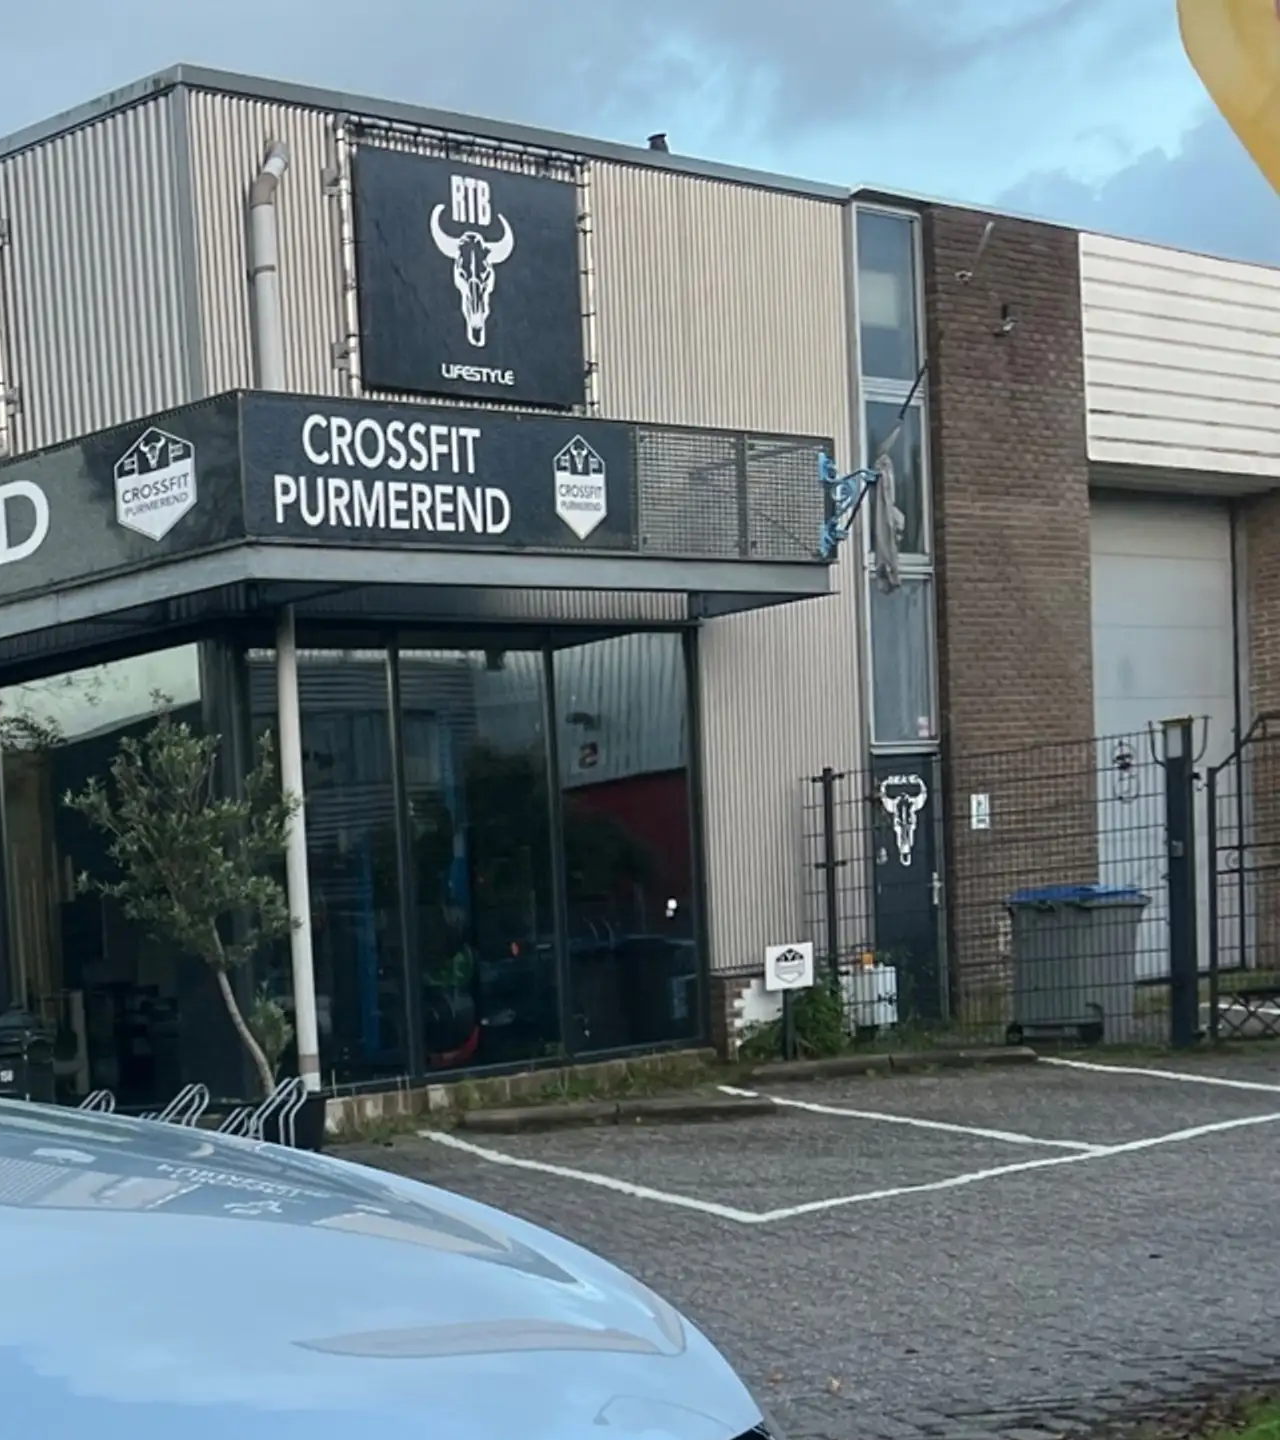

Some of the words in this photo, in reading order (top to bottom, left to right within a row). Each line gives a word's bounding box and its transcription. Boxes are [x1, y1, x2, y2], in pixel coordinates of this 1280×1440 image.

[450, 174, 491, 226] RTB
[441, 362, 515, 386] LIFESTYLE
[301, 413, 482, 475] CROSSFIT
[122, 472, 190, 504] CROSSFIT
[273, 474, 511, 535] PURMEREND
